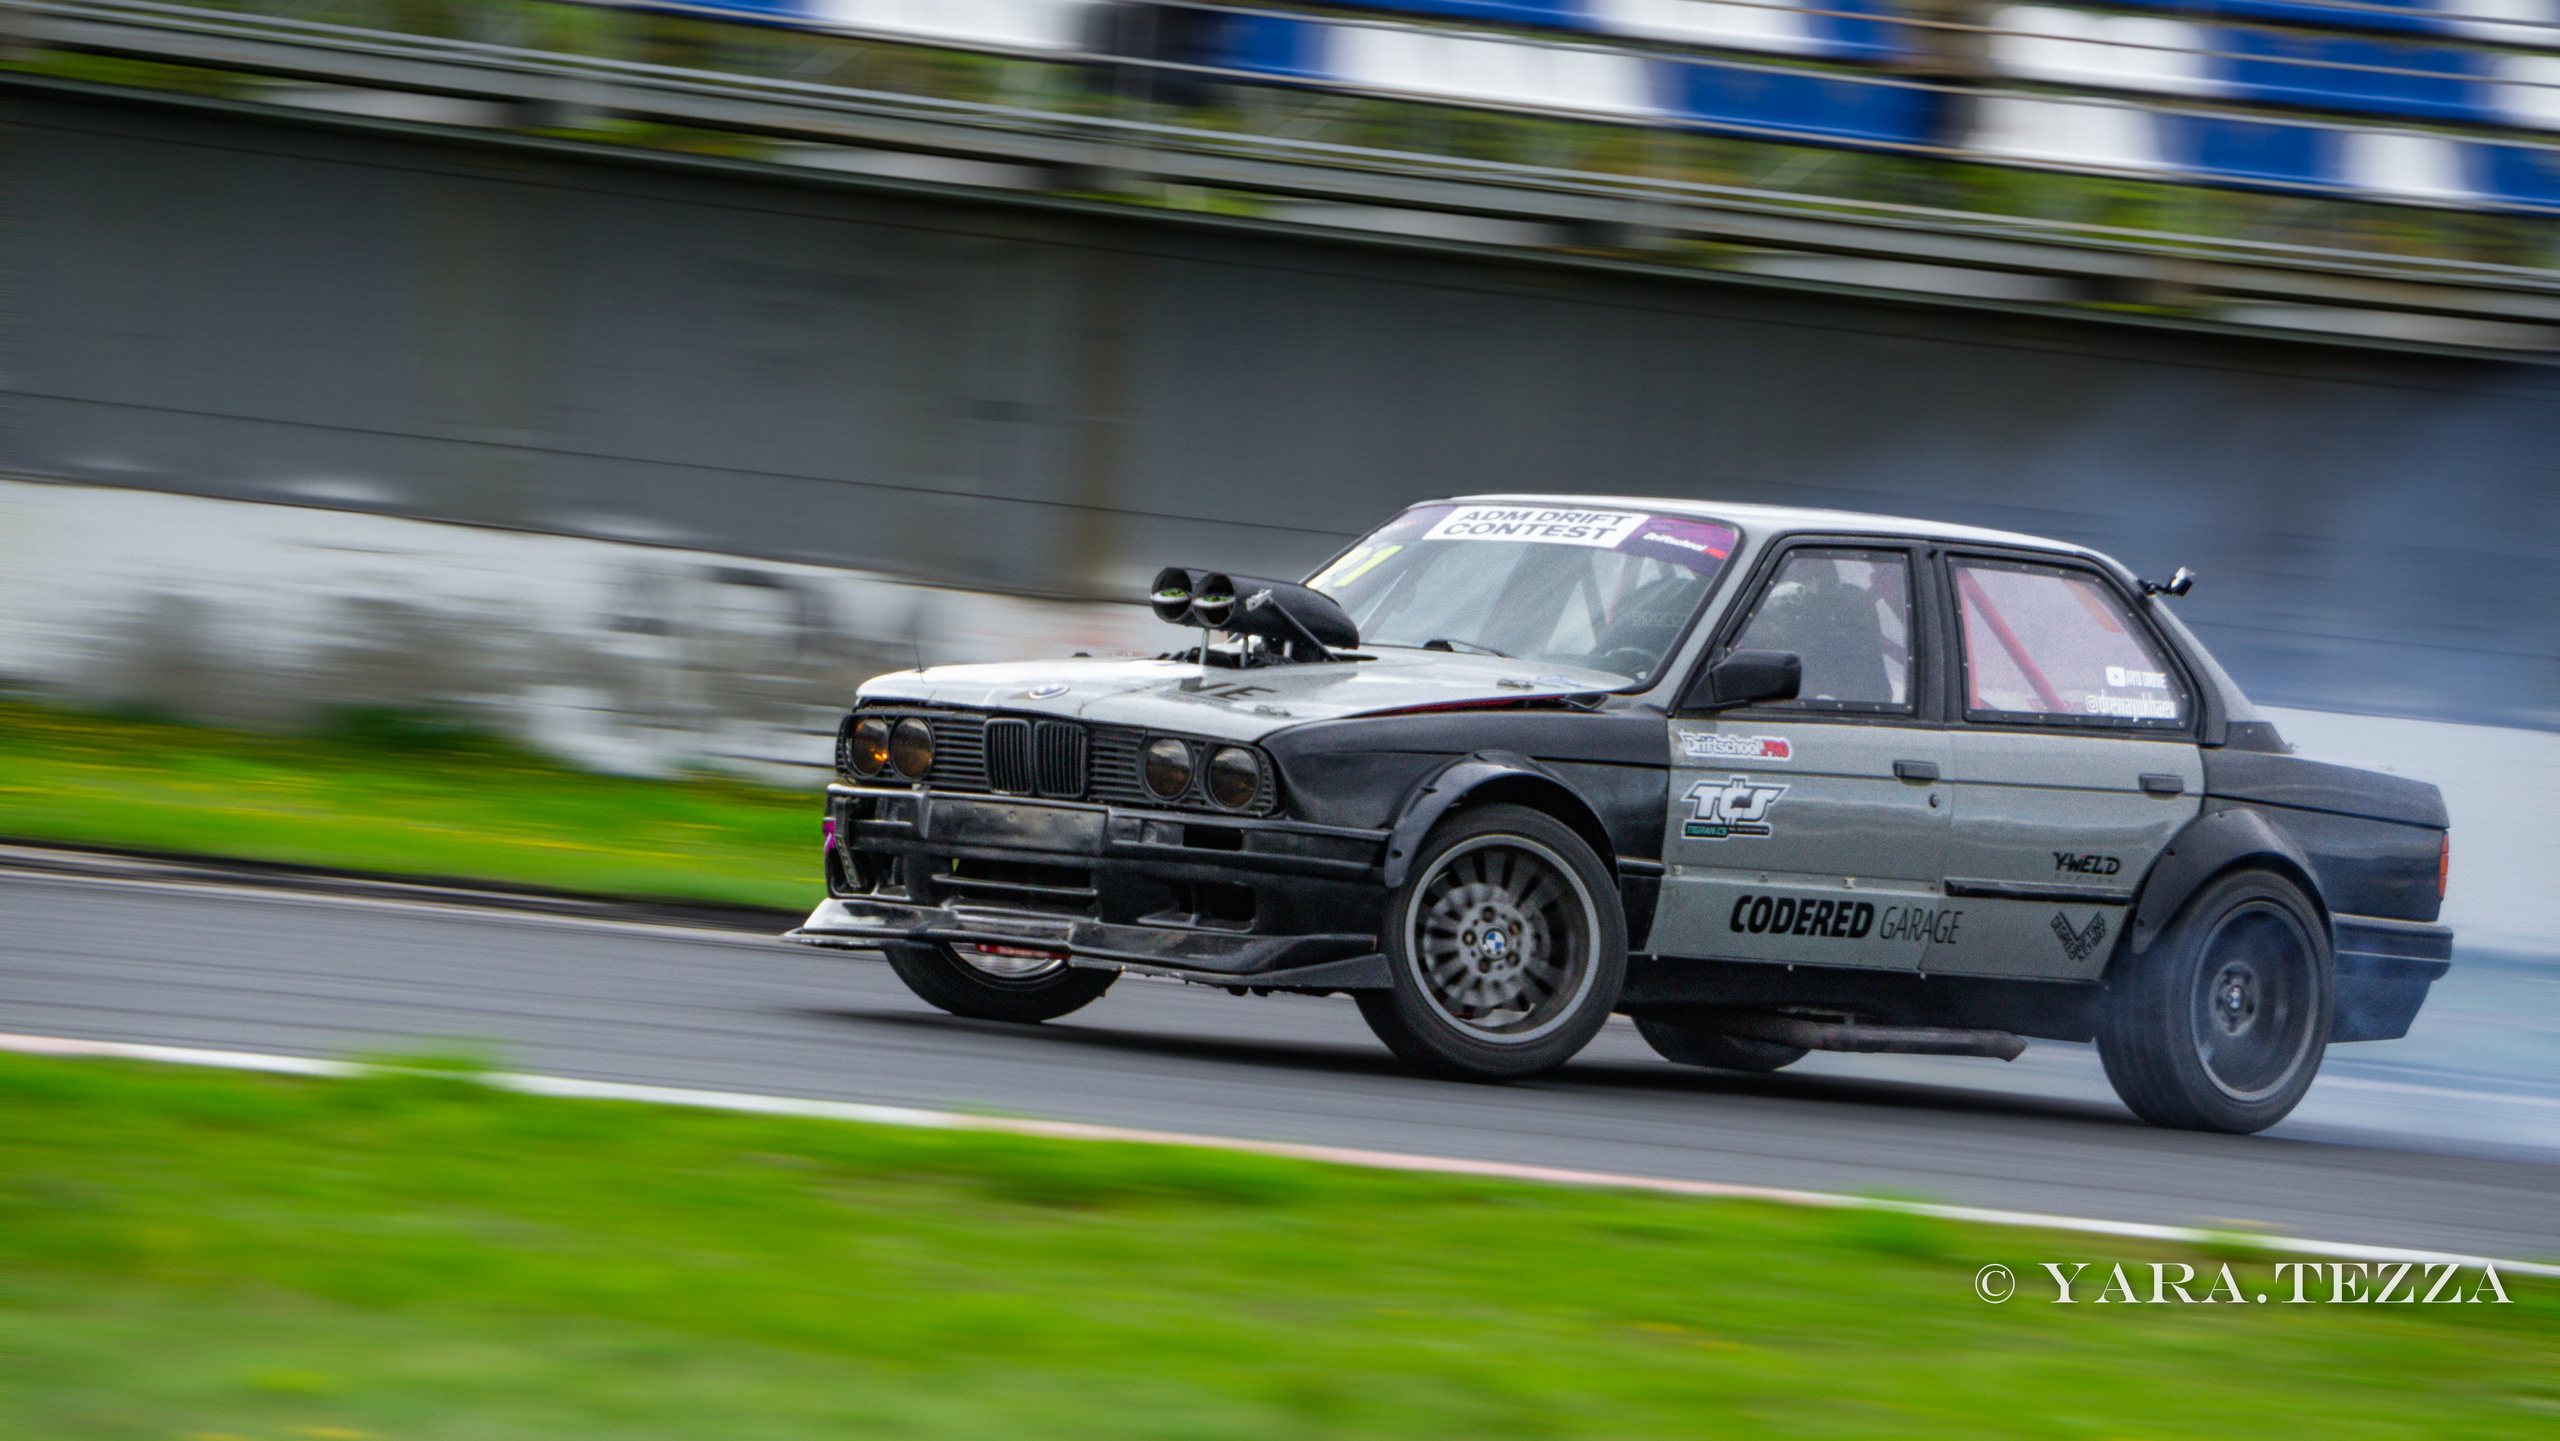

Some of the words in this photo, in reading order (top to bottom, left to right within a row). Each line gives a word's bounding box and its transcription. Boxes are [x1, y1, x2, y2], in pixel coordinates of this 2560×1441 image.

[1458, 510, 1532, 522] ADM
[1535, 511, 1633, 526] DRIFT
[1442, 522, 1618, 540] CONTEST
[1729, 894, 1875, 939] CODERED
[1879, 906, 1964, 944] GARAGE
